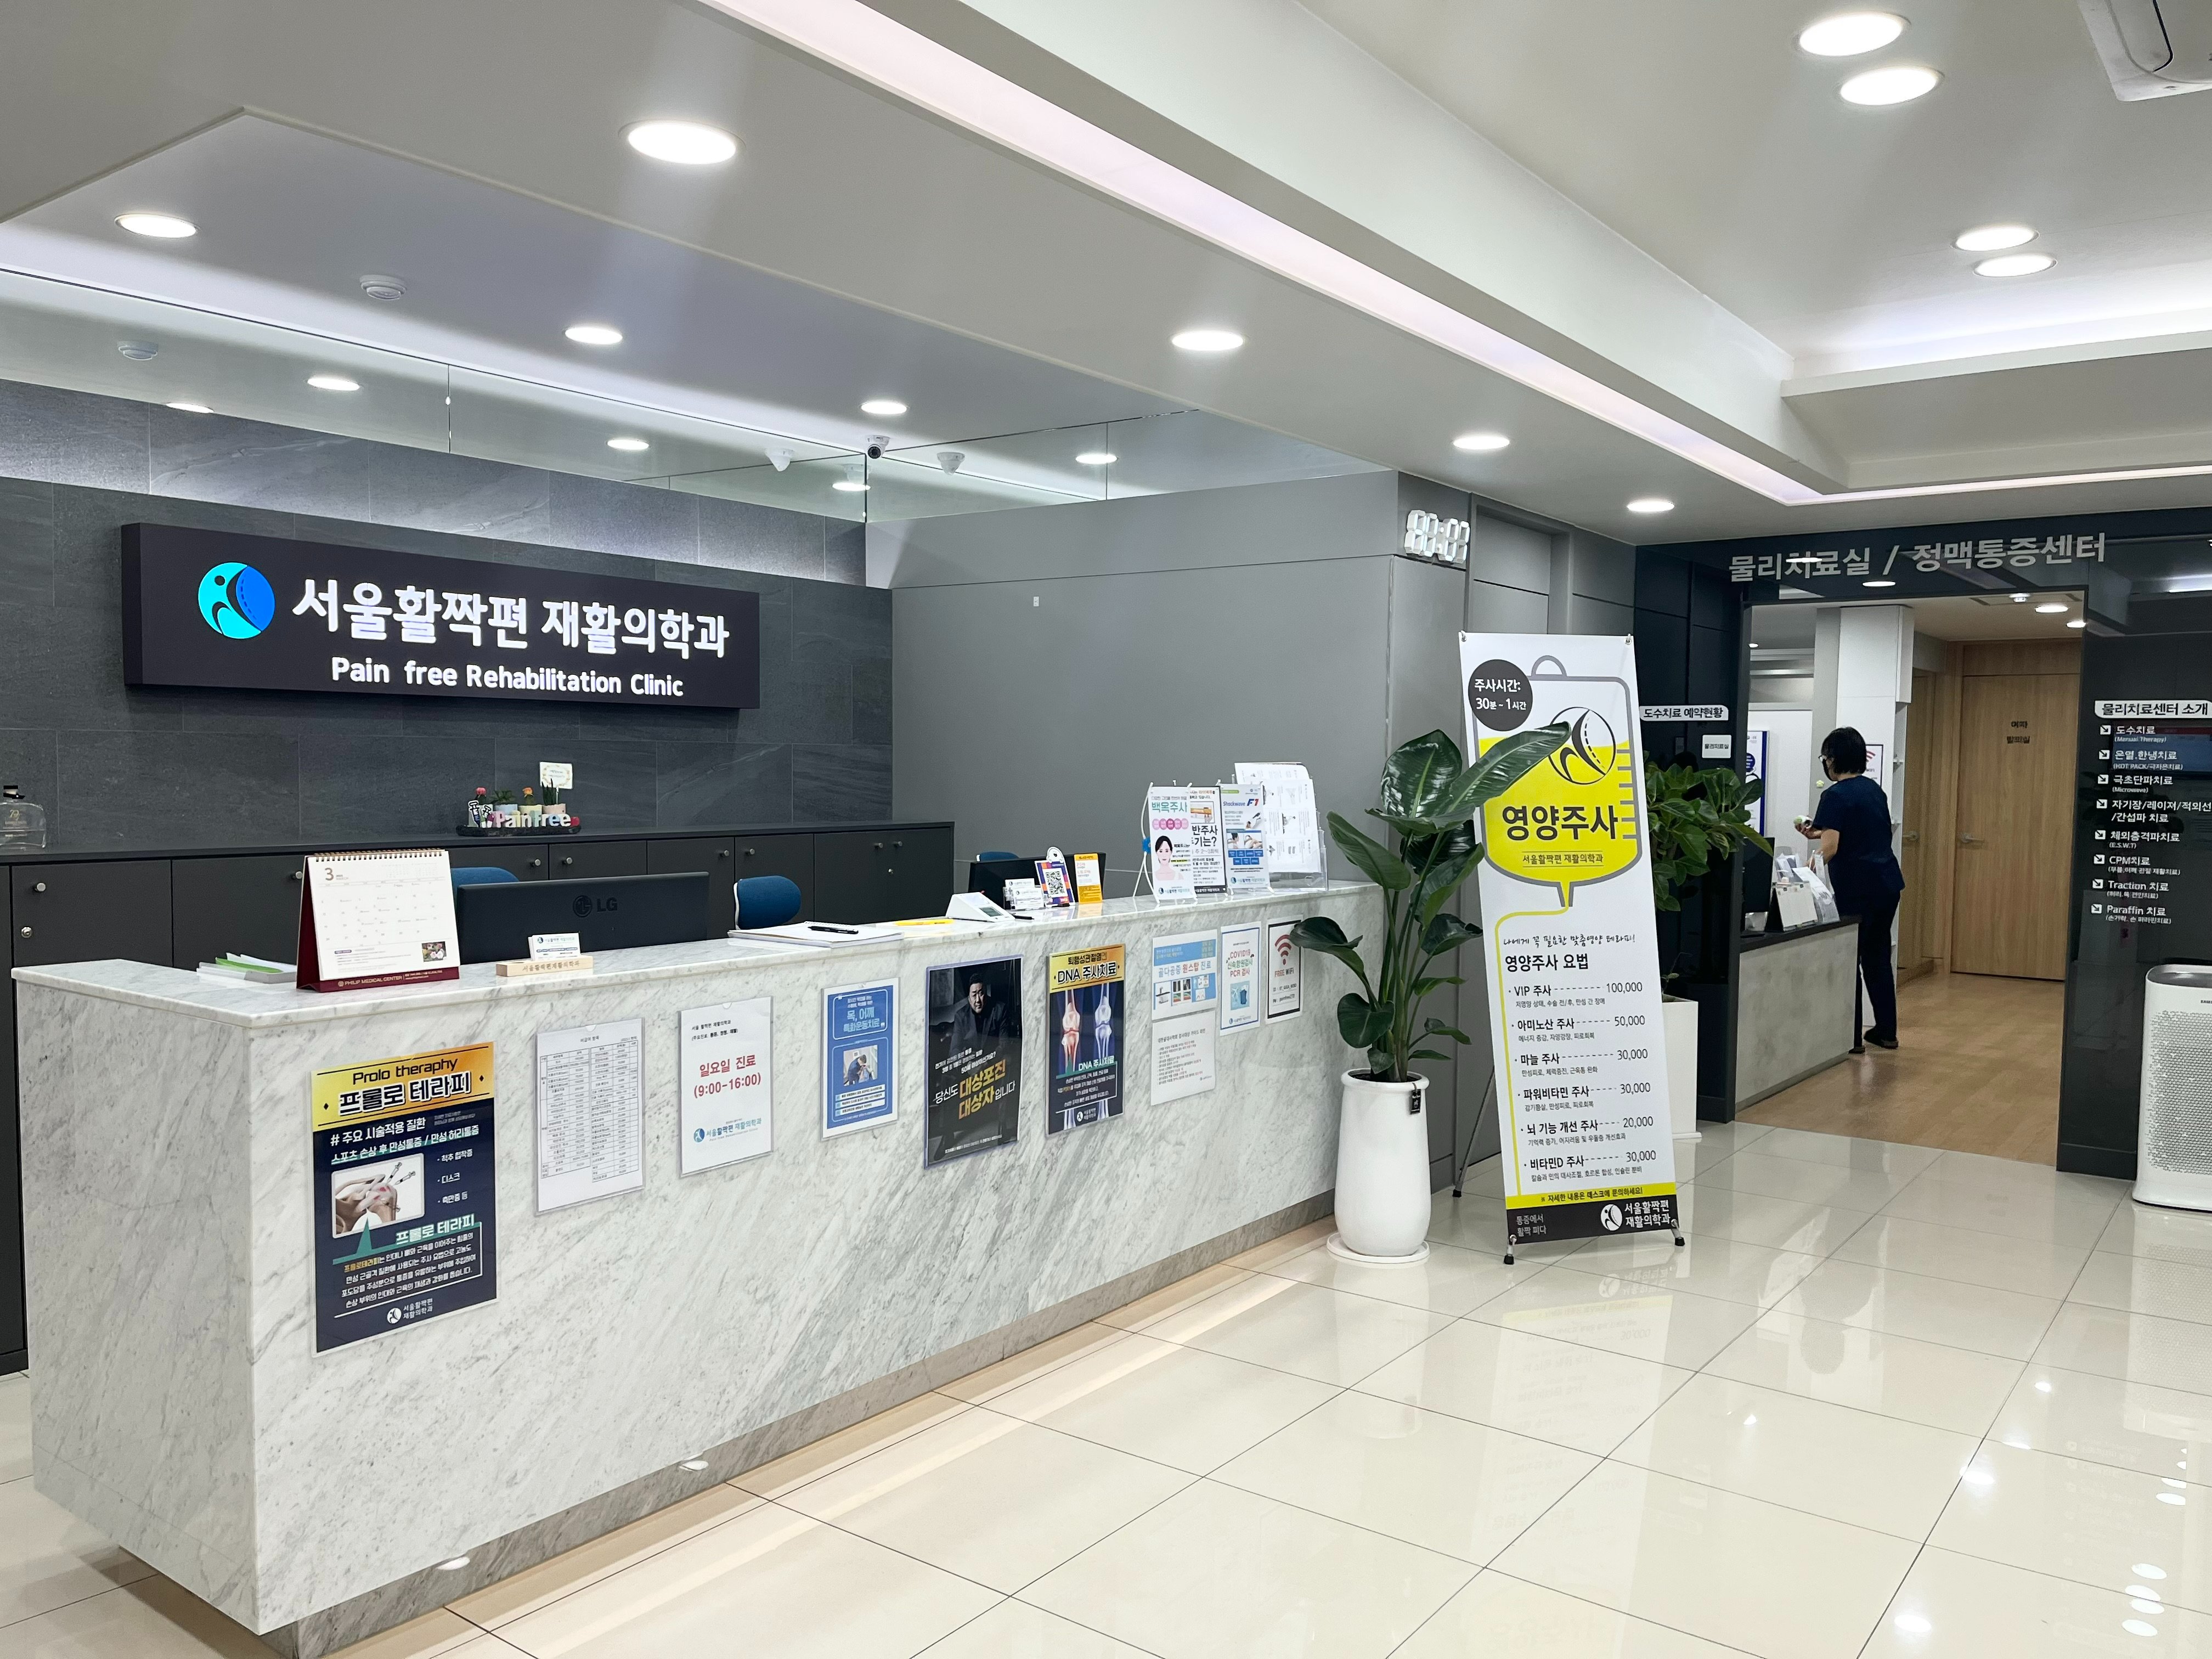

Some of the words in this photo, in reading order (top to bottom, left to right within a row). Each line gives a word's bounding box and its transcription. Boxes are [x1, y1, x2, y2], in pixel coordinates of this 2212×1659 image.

[1729, 548, 1871, 582] 물리치료실
[1912, 533, 2105, 572] 정맥통증센터
[294, 578, 527, 650] 서울활짝편
[541, 599, 729, 659] 재활의학과
[332, 658, 390, 684] Pain
[404, 661, 457, 686] free
[467, 665, 622, 694] Rehabilitation
[630, 673, 683, 696] Clinic
[1474, 679, 1521, 692] 주사시간:
[1476, 698, 1497, 710] 30분
[1505, 698, 1526, 710] 1시간
[2102, 703, 2178, 715] 물리치료센터
[2181, 703, 2208, 715] 소개
[1644, 709, 1681, 718] 도수치료
[1684, 708, 1723, 718] 예약현황
[2116, 726, 2156, 734] 도수치료
[2113, 775, 2173, 786] 극초단파치료
[1152, 802, 1187, 812] 백옥주사
[2112, 800, 2211, 812] 자기장/레이저/적외선
[1503, 805, 1618, 840] 영양주사
[2112, 813, 2146, 822] /간섭파
[2149, 814, 2169, 822] 치료
[1192, 837, 1216, 847] 기는?
[2111, 831, 2180, 842] 체외충격파치료
[1523, 854, 1562, 865] 서울활짝편
[1564, 853, 1603, 864] 재활의학과
[2109, 856, 2150, 866] CPM치료
[325, 867, 334, 881] 3
[2108, 881, 2146, 890] Traction
[2149, 883, 2169, 891] 치료
[597, 898, 618, 912] LG
[2107, 905, 2143, 915] Paraffin
[2146, 907, 2166, 916] 치료
[1533, 936, 1539, 948] 꼭
[1543, 935, 1567, 947] 필요한
[1231, 949, 1250, 958] COVID19
[1159, 965, 1181, 978] 골다공증
[1201, 961, 1211, 970] 진료
[1228, 958, 1252, 969] 신속항원검사
[1505, 954, 1558, 972] 영양주사
[1564, 953, 1588, 969] 요법
[1058, 969, 1080, 983] DNA
[1083, 962, 1116, 980] 주사치료
[1514, 986, 1530, 996] VIP
[1533, 985, 1551, 996] 주사
[1606, 982, 1642, 994] 100,000
[859, 1007, 874, 1019] 어깨
[1517, 1019, 1553, 1031] 아미노산
[1557, 1018, 1574, 1029] 주사
[1615, 1015, 1645, 1027] 50,000
[1079, 1061, 1092, 1071] DNA
[1093, 1056, 1114, 1068] 주사치료
[1521, 1054, 1538, 1065] 마늘
[1542, 1053, 1560, 1064] 주사
[1617, 1049, 1647, 1060] 30,000
[353, 1070, 390, 1085] Prolo
[396, 1059, 458, 1077] theraphy
[700, 1059, 730, 1077] 일요일
[736, 1055, 756, 1069] 진료
[409, 1071, 471, 1102] 테라피
[694, 1073, 761, 1098] (9:00-16:00)
[935, 1084, 958, 1104] 당신도
[960, 1059, 1006, 1098] 대상포진
[1523, 1088, 1568, 1101] 파워비타민
[1572, 1085, 1589, 1097] 주사
[1620, 1082, 1650, 1094] 30,000
[342, 1130, 363, 1143] 주요
[366, 1122, 404, 1139] 시술적용
[407, 1118, 426, 1132] 질환
[1527, 1124, 1536, 1136] 뇌
[1539, 1123, 1556, 1135] 기능
[1560, 1121, 1577, 1133] 개선
[1581, 1119, 1598, 1131] 주사
[1623, 1116, 1653, 1129] 20,000
[331, 1150, 358, 1164] 스포츠
[360, 1146, 376, 1159] 손상
[431, 1132, 447, 1144] 만성
[1530, 1158, 1564, 1170] 비타민D
[1567, 1155, 1584, 1167] 주사
[1626, 1150, 1656, 1163] 30,000
[441, 1173, 460, 1184] 디스크
[1625, 1200, 1669, 1214] 서울활짝편
[437, 1214, 475, 1234] 테라피
[1516, 1214, 1544, 1225] 통증에서
[1626, 1214, 1671, 1228] 재활의학과
[1517, 1227, 1531, 1237] 활짝
[1533, 1225, 1547, 1235] 피다
